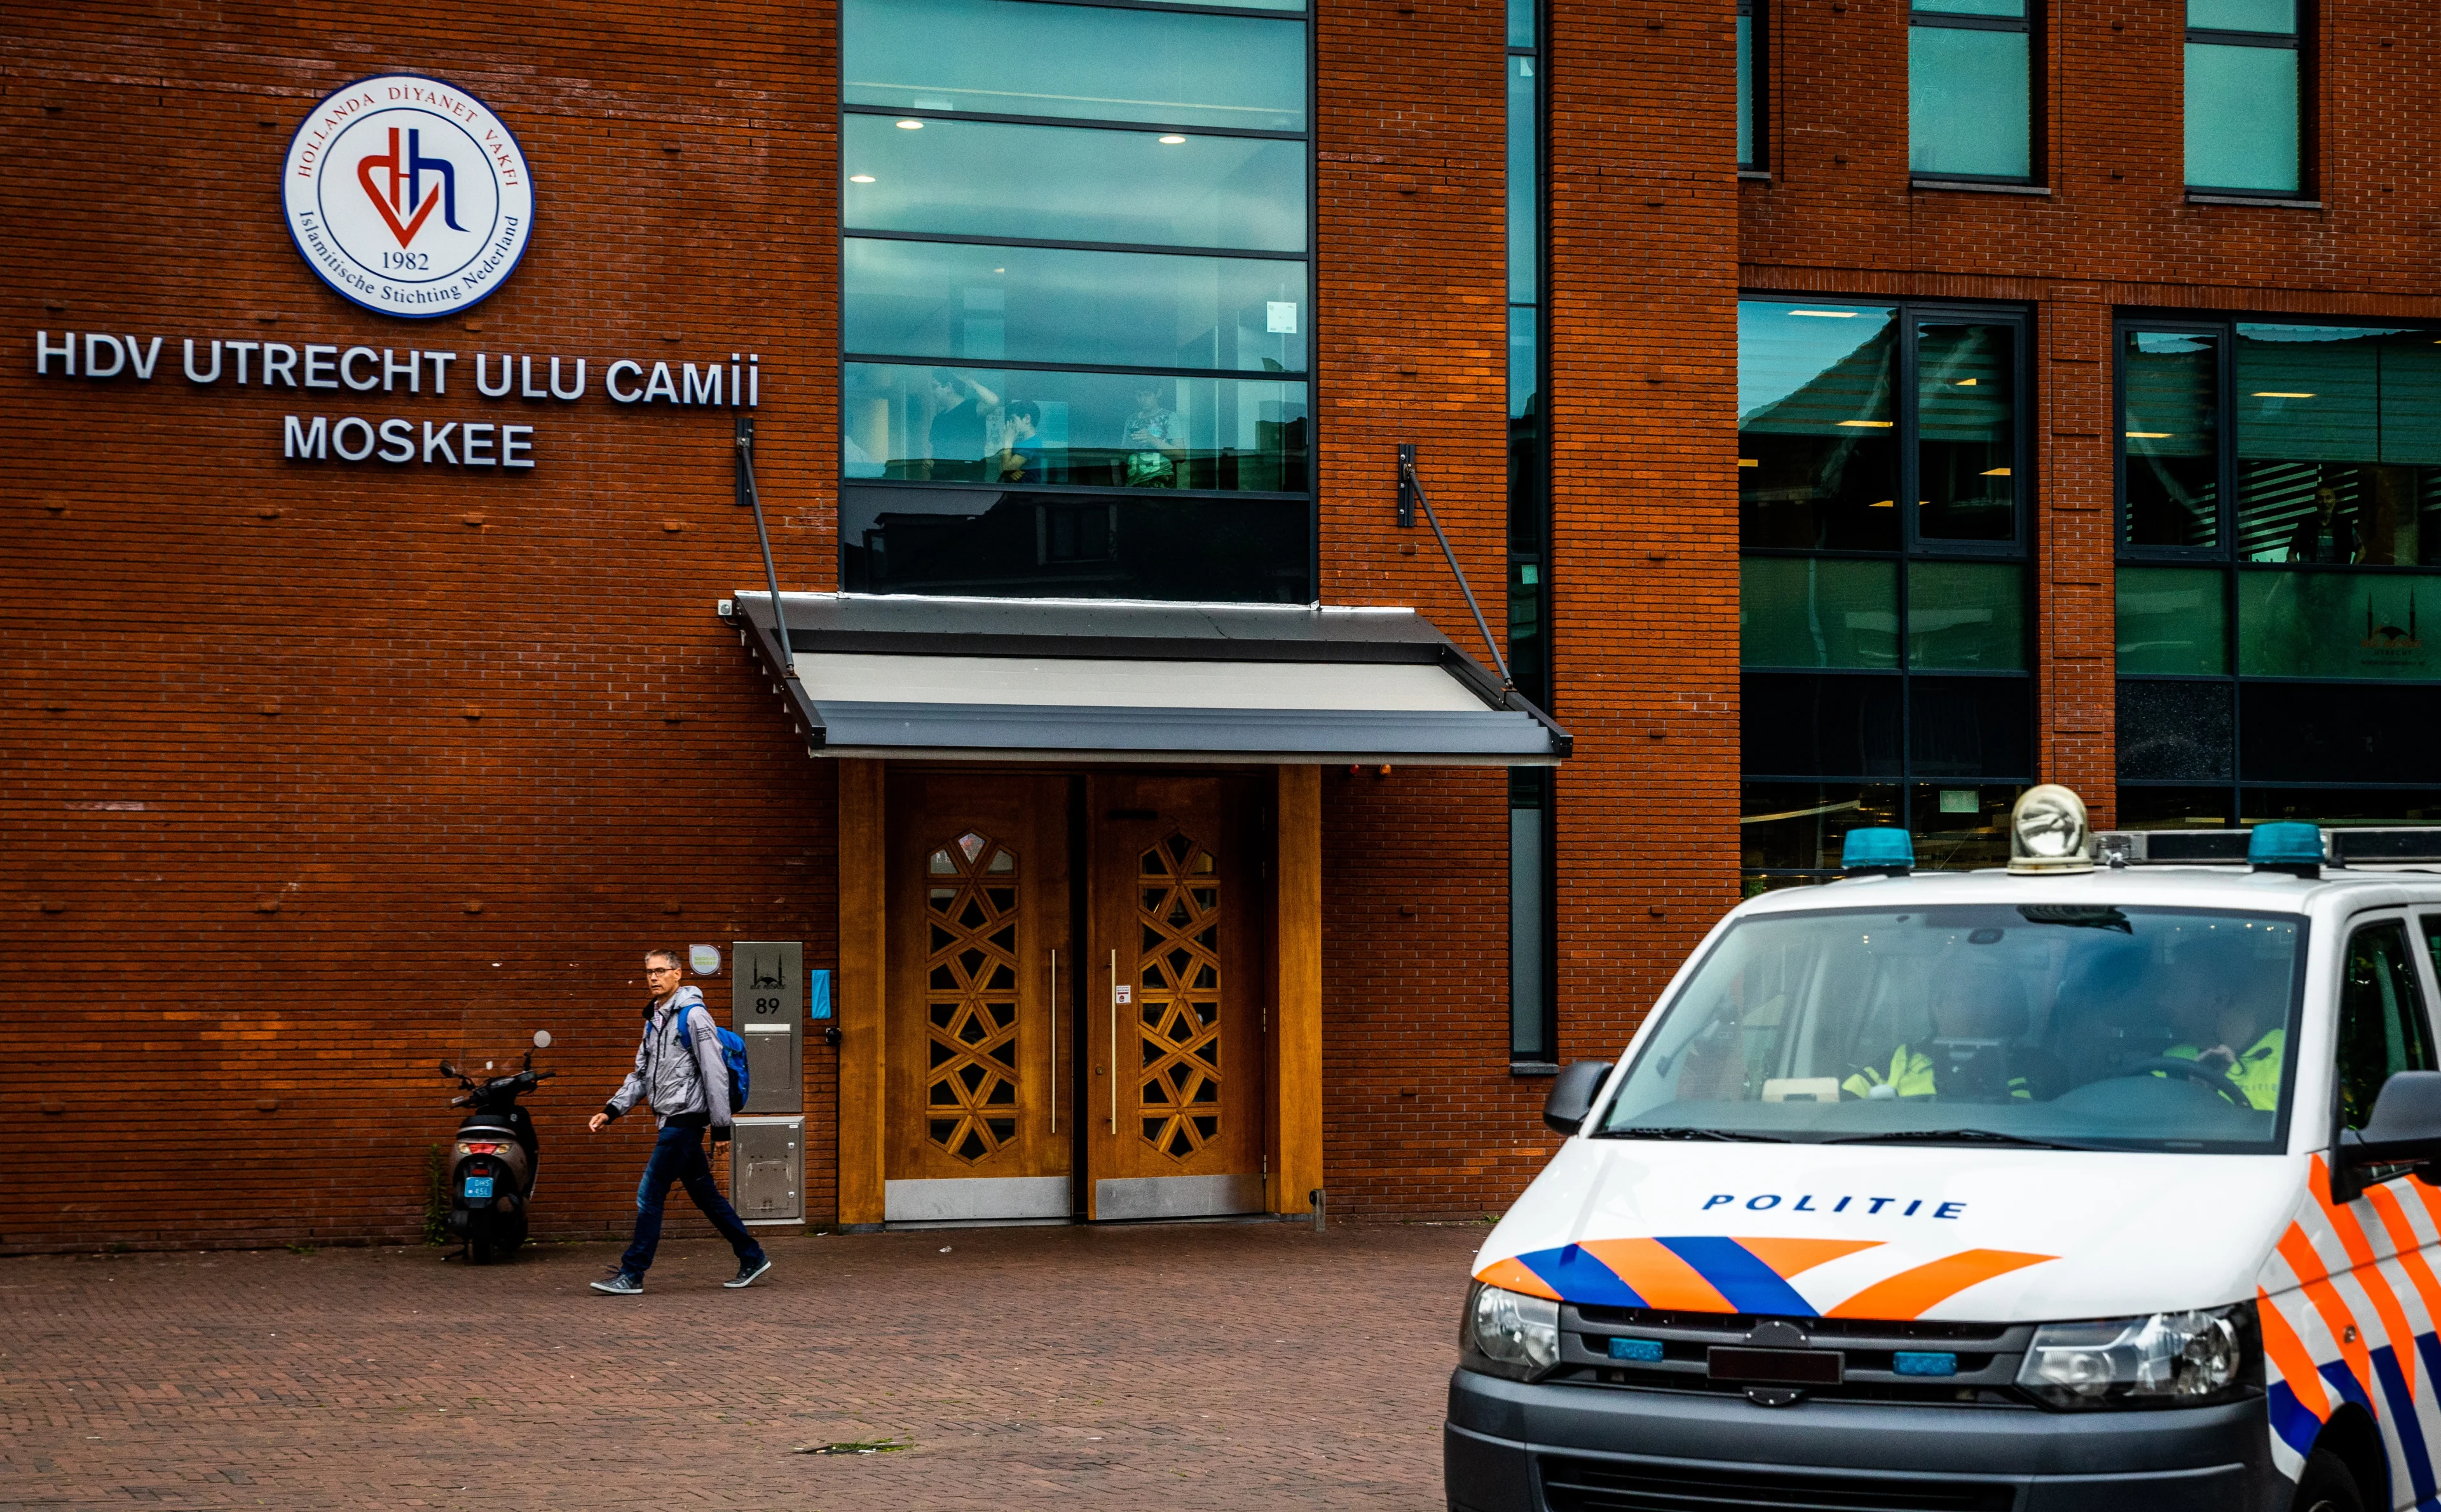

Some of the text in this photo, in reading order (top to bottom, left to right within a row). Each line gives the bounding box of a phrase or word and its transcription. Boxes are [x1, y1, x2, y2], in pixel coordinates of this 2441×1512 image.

[297, 92, 376, 179] HOLLANDA
[484, 128, 518, 187] VAKFI
[299, 210, 519, 304] Islamitische Stichting Nederland
[381, 250, 430, 271] 1982
[36, 330, 163, 380] HDV
[182, 337, 458, 395] UTRECHT
[475, 353, 587, 400] ULU
[283, 415, 536, 469] MOSKEE
[756, 998, 780, 1014] 89
[1702, 1194, 1967, 1219] POLITIE
